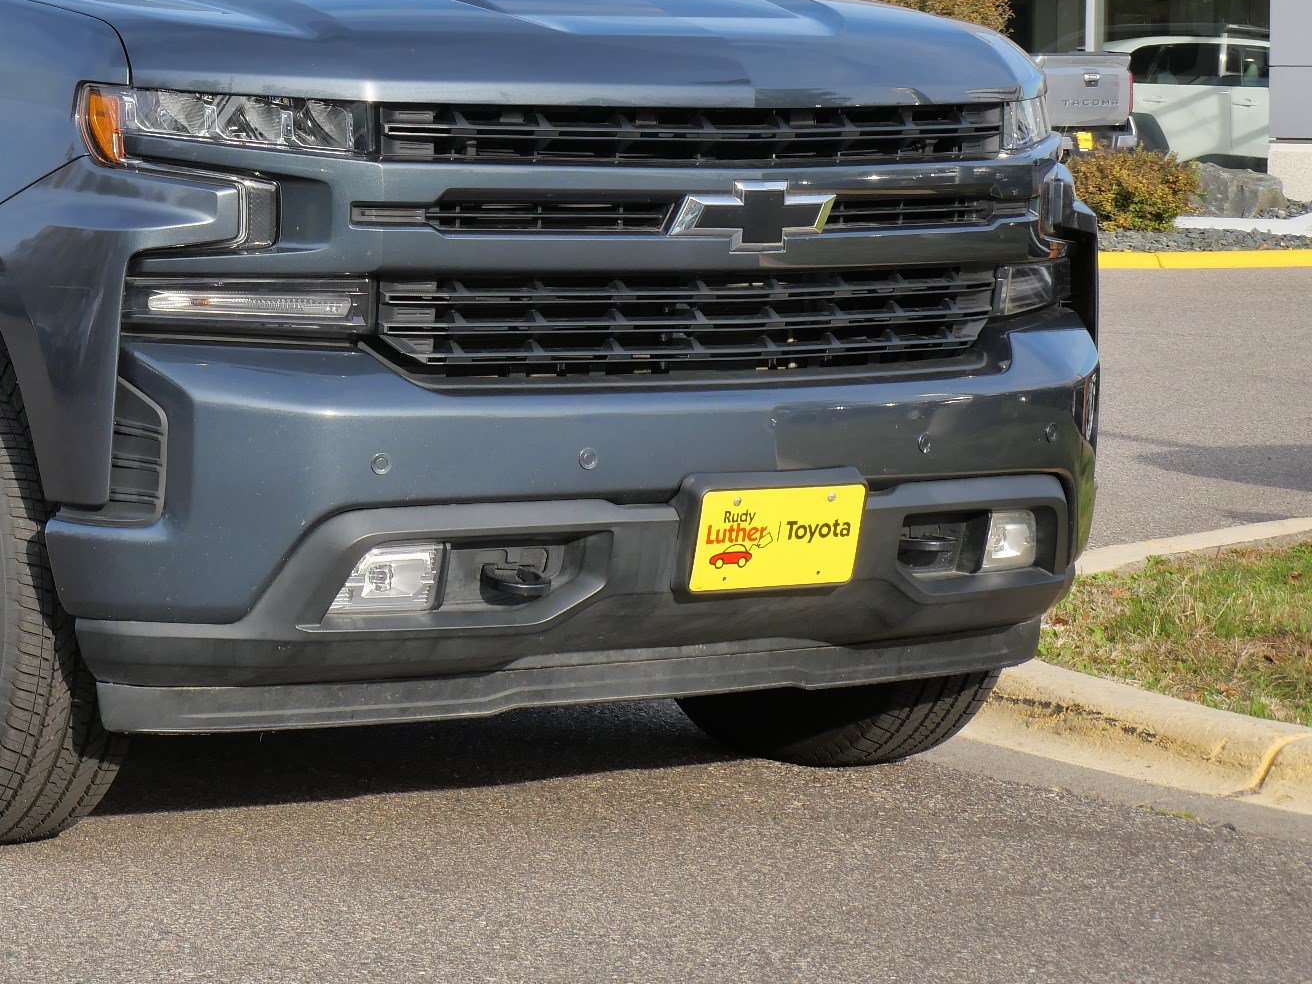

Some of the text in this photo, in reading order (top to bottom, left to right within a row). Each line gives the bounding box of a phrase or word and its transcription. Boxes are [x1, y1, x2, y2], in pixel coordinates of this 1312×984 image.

[1061, 99, 1120, 107] TACOMA
[723, 510, 756, 525] Rudy
[706, 519, 850, 544] Luther Toyota
